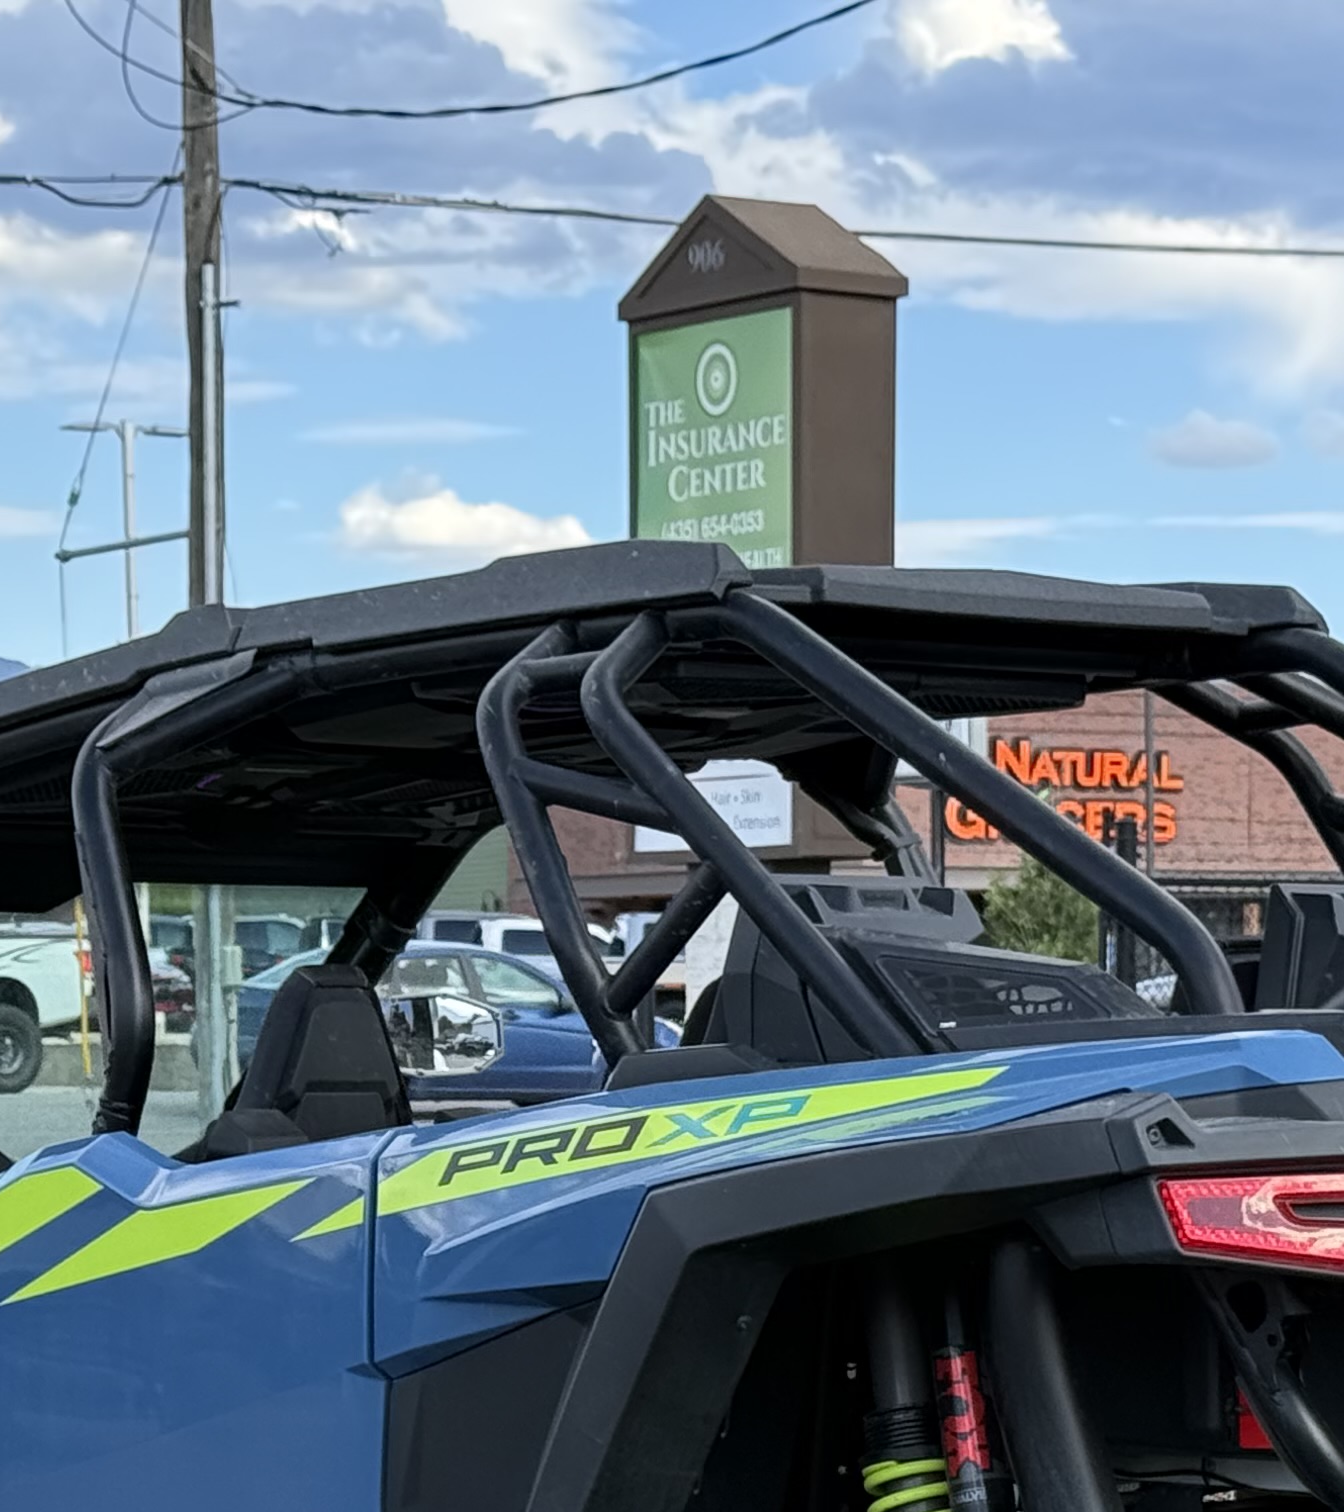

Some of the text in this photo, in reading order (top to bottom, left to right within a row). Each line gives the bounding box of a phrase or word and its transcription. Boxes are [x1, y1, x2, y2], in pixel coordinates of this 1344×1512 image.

[688, 240, 725, 273] 906
[644, 399, 685, 427] THE
[647, 414, 786, 467] INSURANCE
[668, 458, 766, 502] CENTER
[995, 739, 1185, 790] NATURAL
